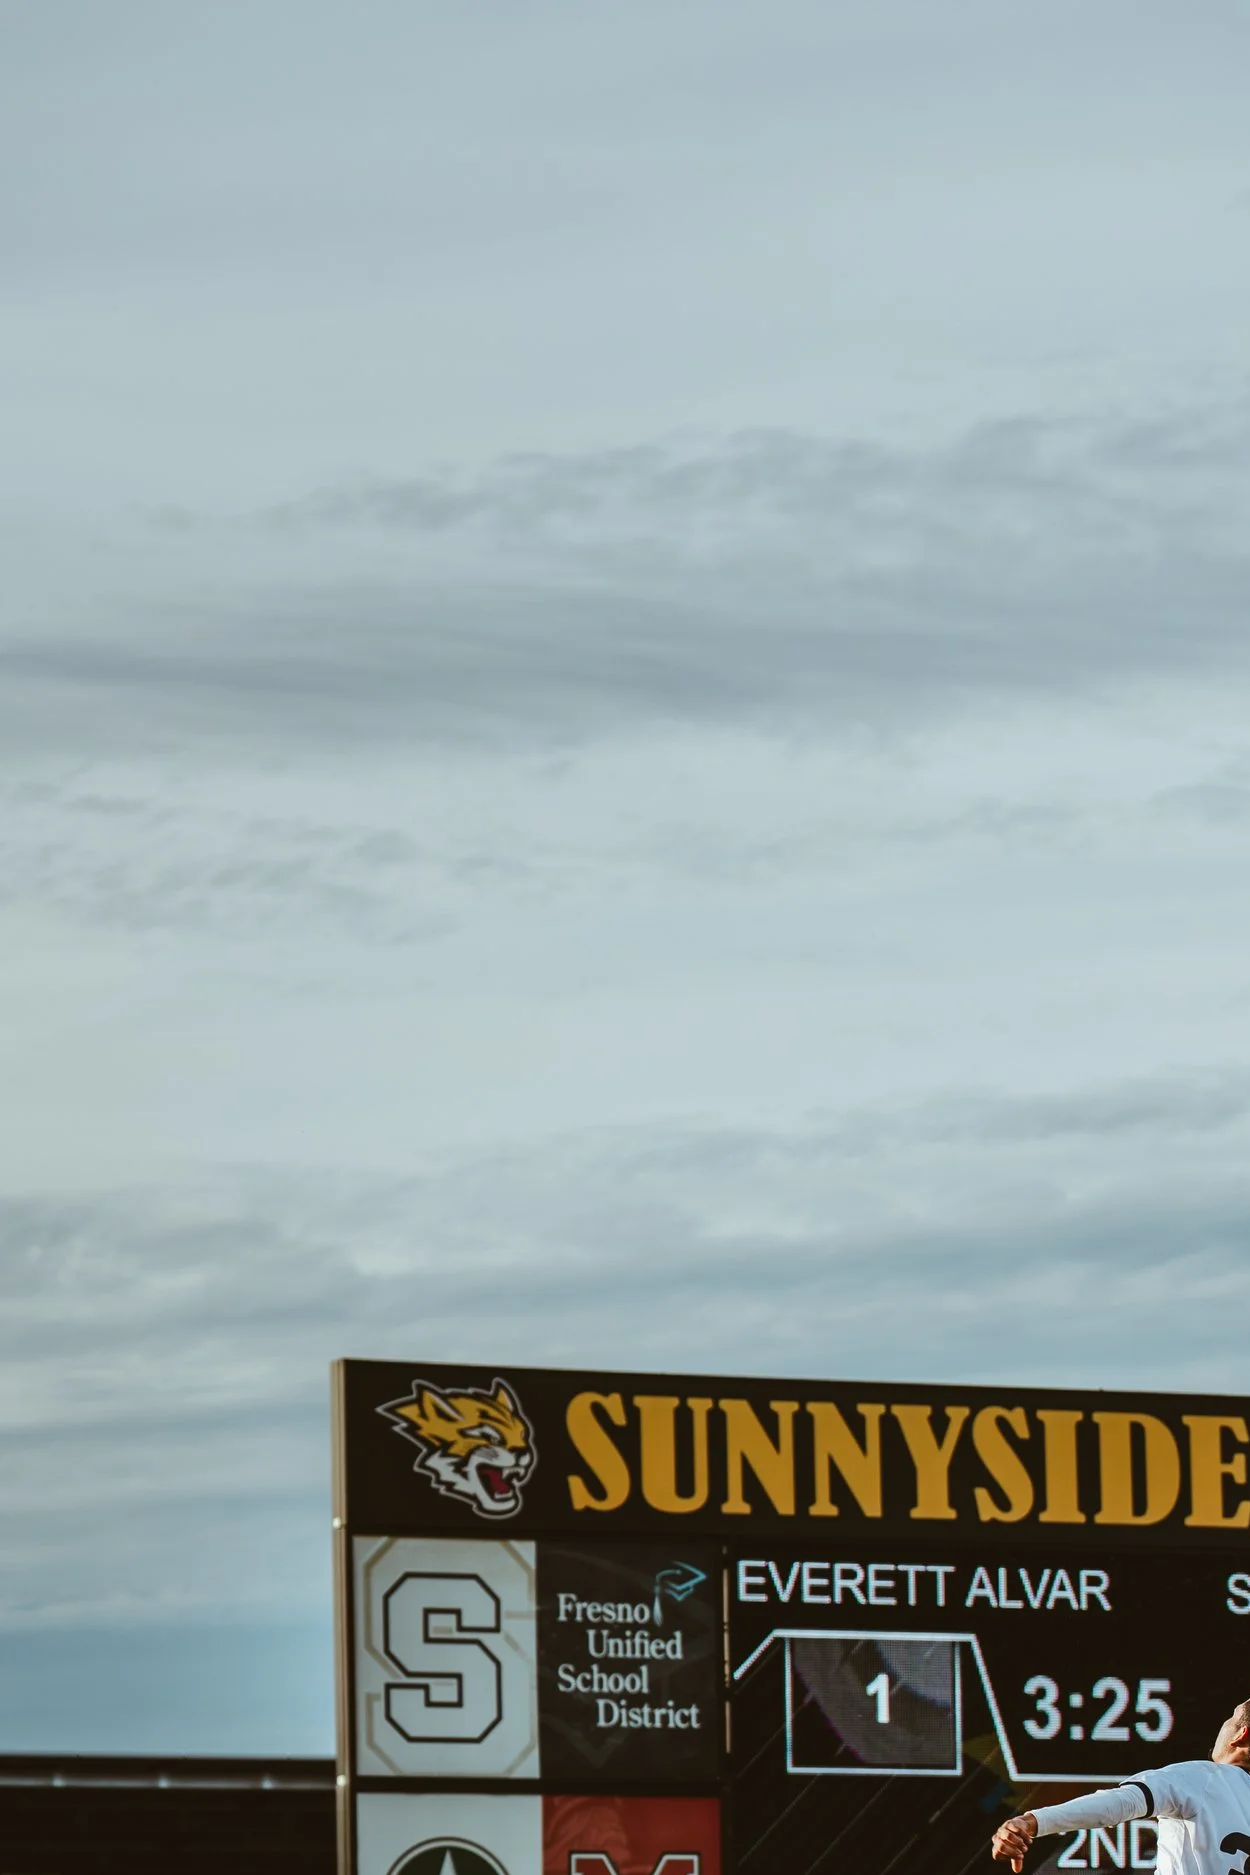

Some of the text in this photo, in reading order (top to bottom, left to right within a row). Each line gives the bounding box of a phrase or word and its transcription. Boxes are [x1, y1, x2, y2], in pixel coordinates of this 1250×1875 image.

[556, 1592, 651, 1624] Fresno
[737, 1560, 1112, 1611] EVERETT ALVAR
[382, 1571, 503, 1744] S
[586, 1629, 684, 1660] Unified
[557, 1663, 650, 1694] School
[865, 1673, 890, 1724] 1
[595, 1699, 701, 1729] District
[1022, 1675, 1174, 1742] 3:25
[1057, 1818, 1160, 1869] 2ND
